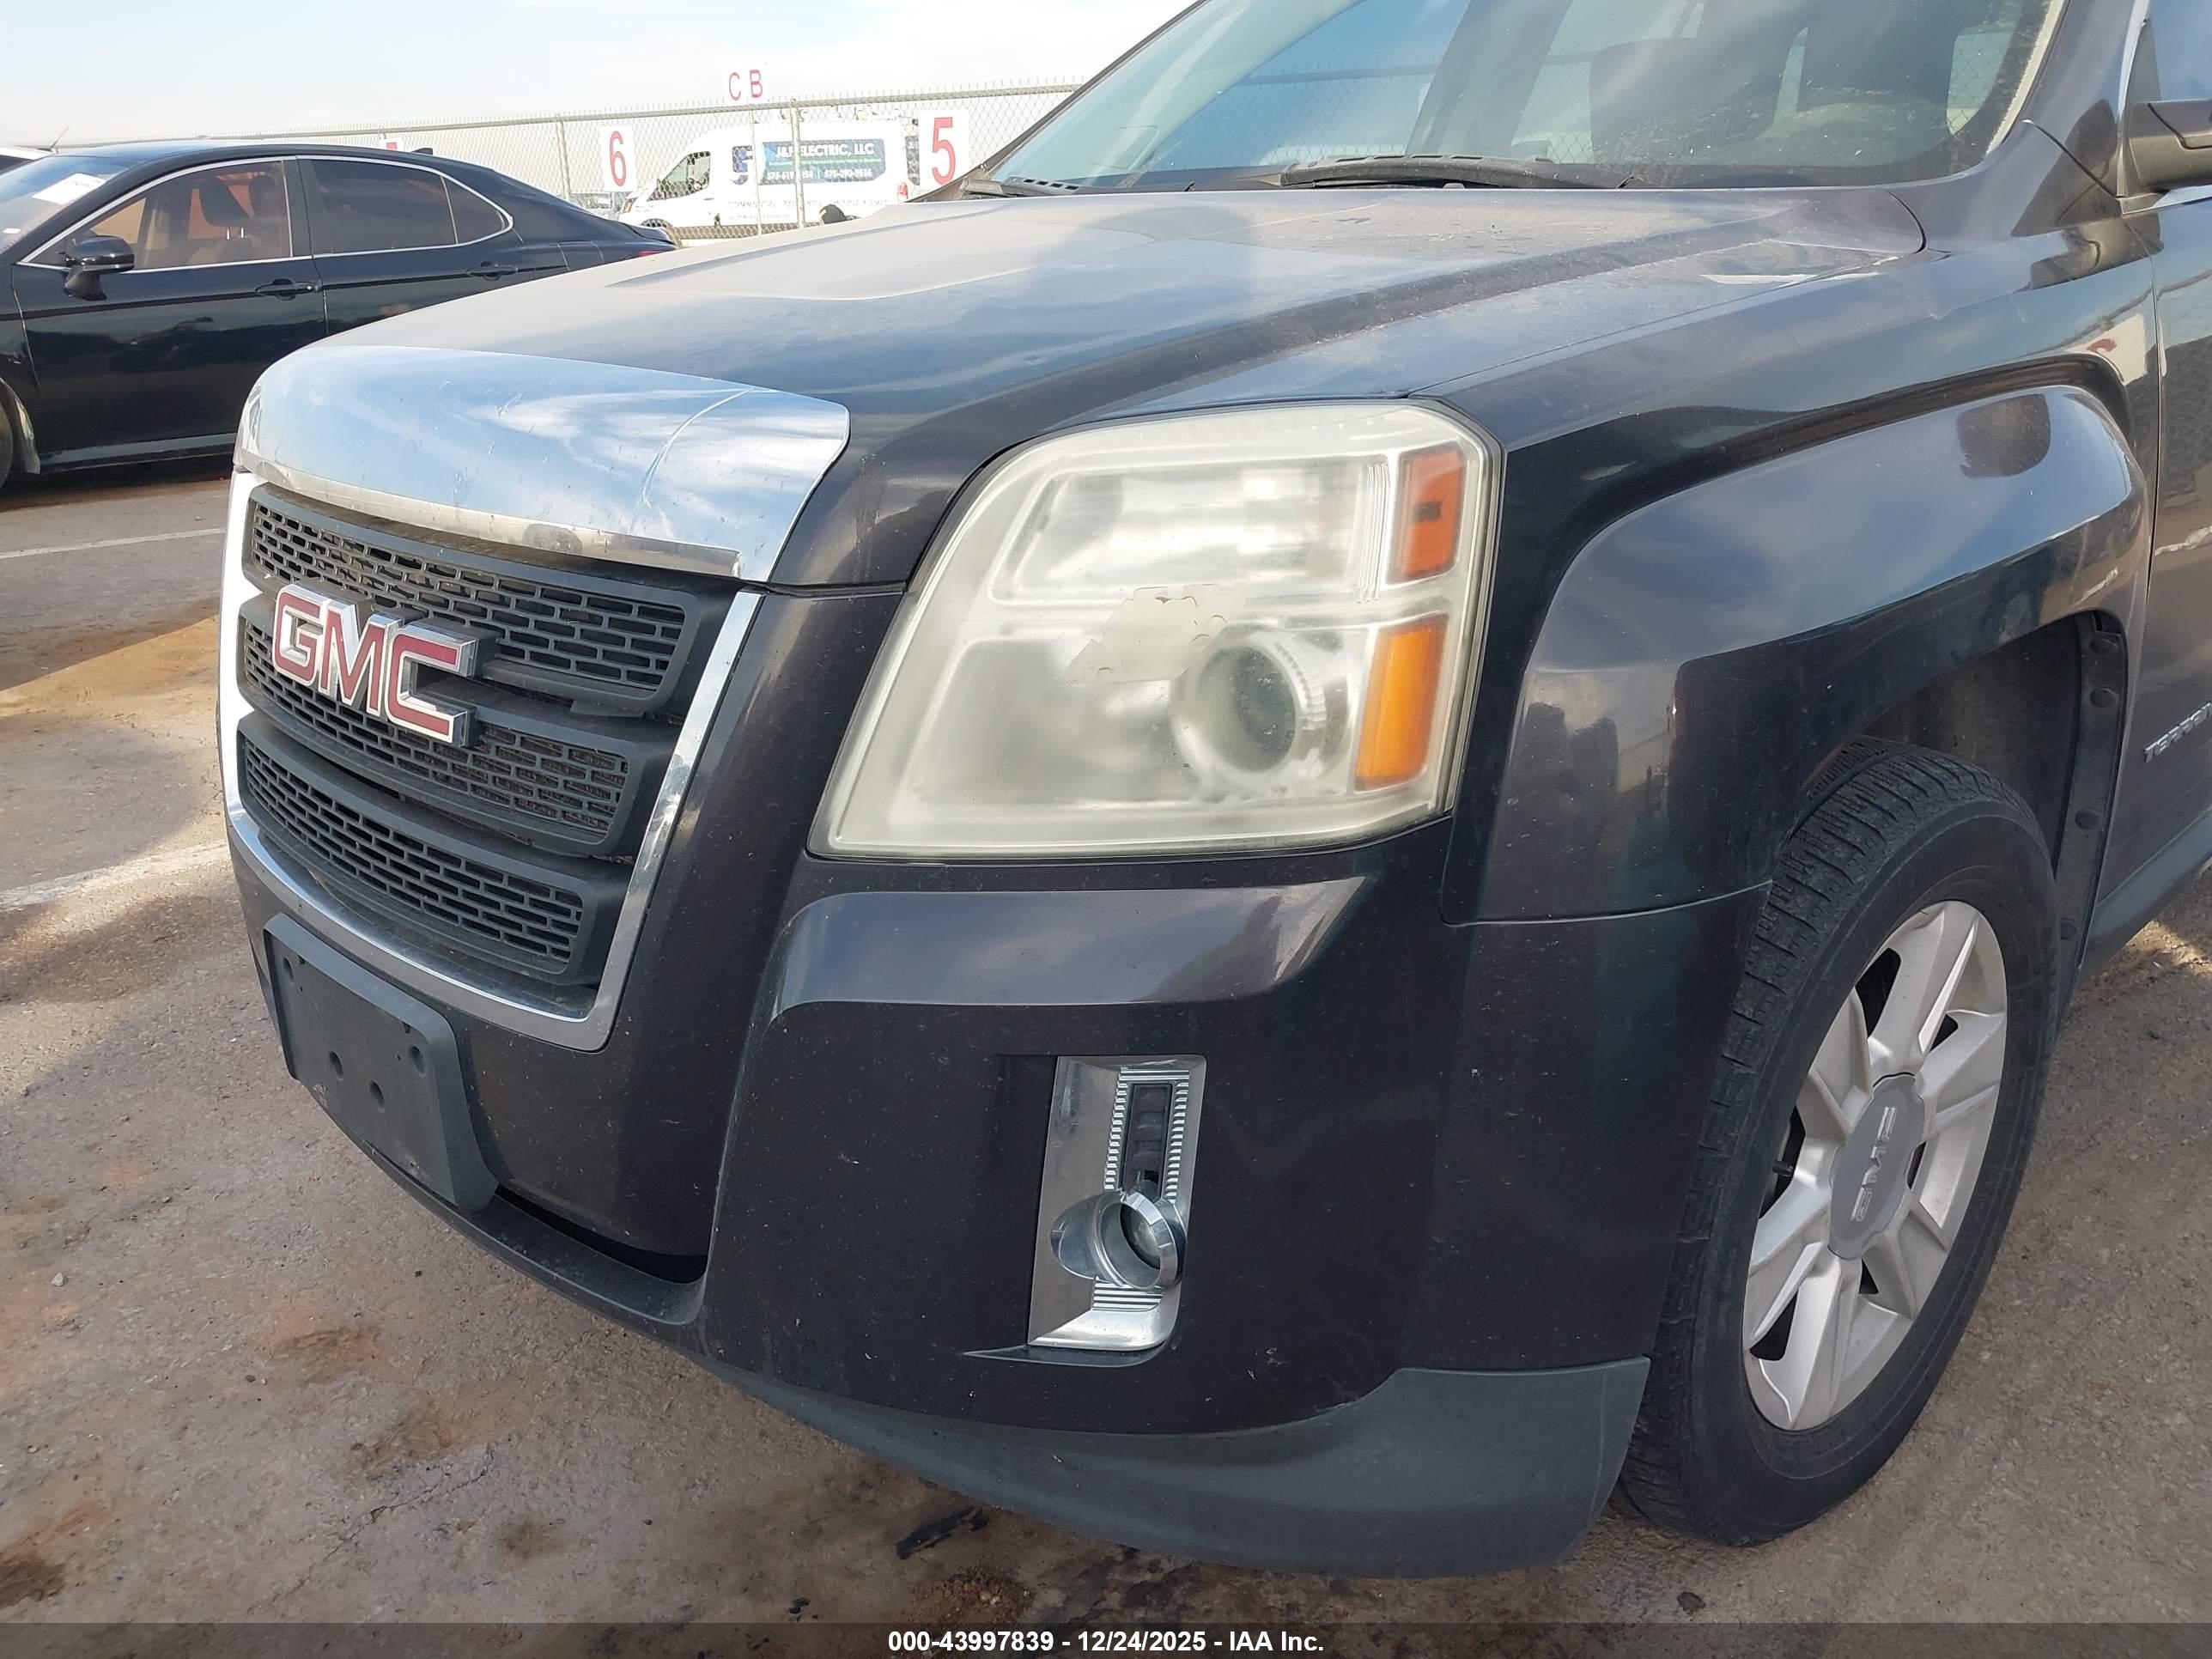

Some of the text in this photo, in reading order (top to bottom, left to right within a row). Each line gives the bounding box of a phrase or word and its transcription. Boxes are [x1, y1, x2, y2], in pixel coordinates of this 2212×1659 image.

[728, 69, 763, 101] C B
[609, 130, 627, 187] 6
[854, 142, 875, 155] LLC
[932, 116, 957, 185] 5
[272, 584, 477, 747] GMC
[1850, 1105, 1897, 1223] GMC
